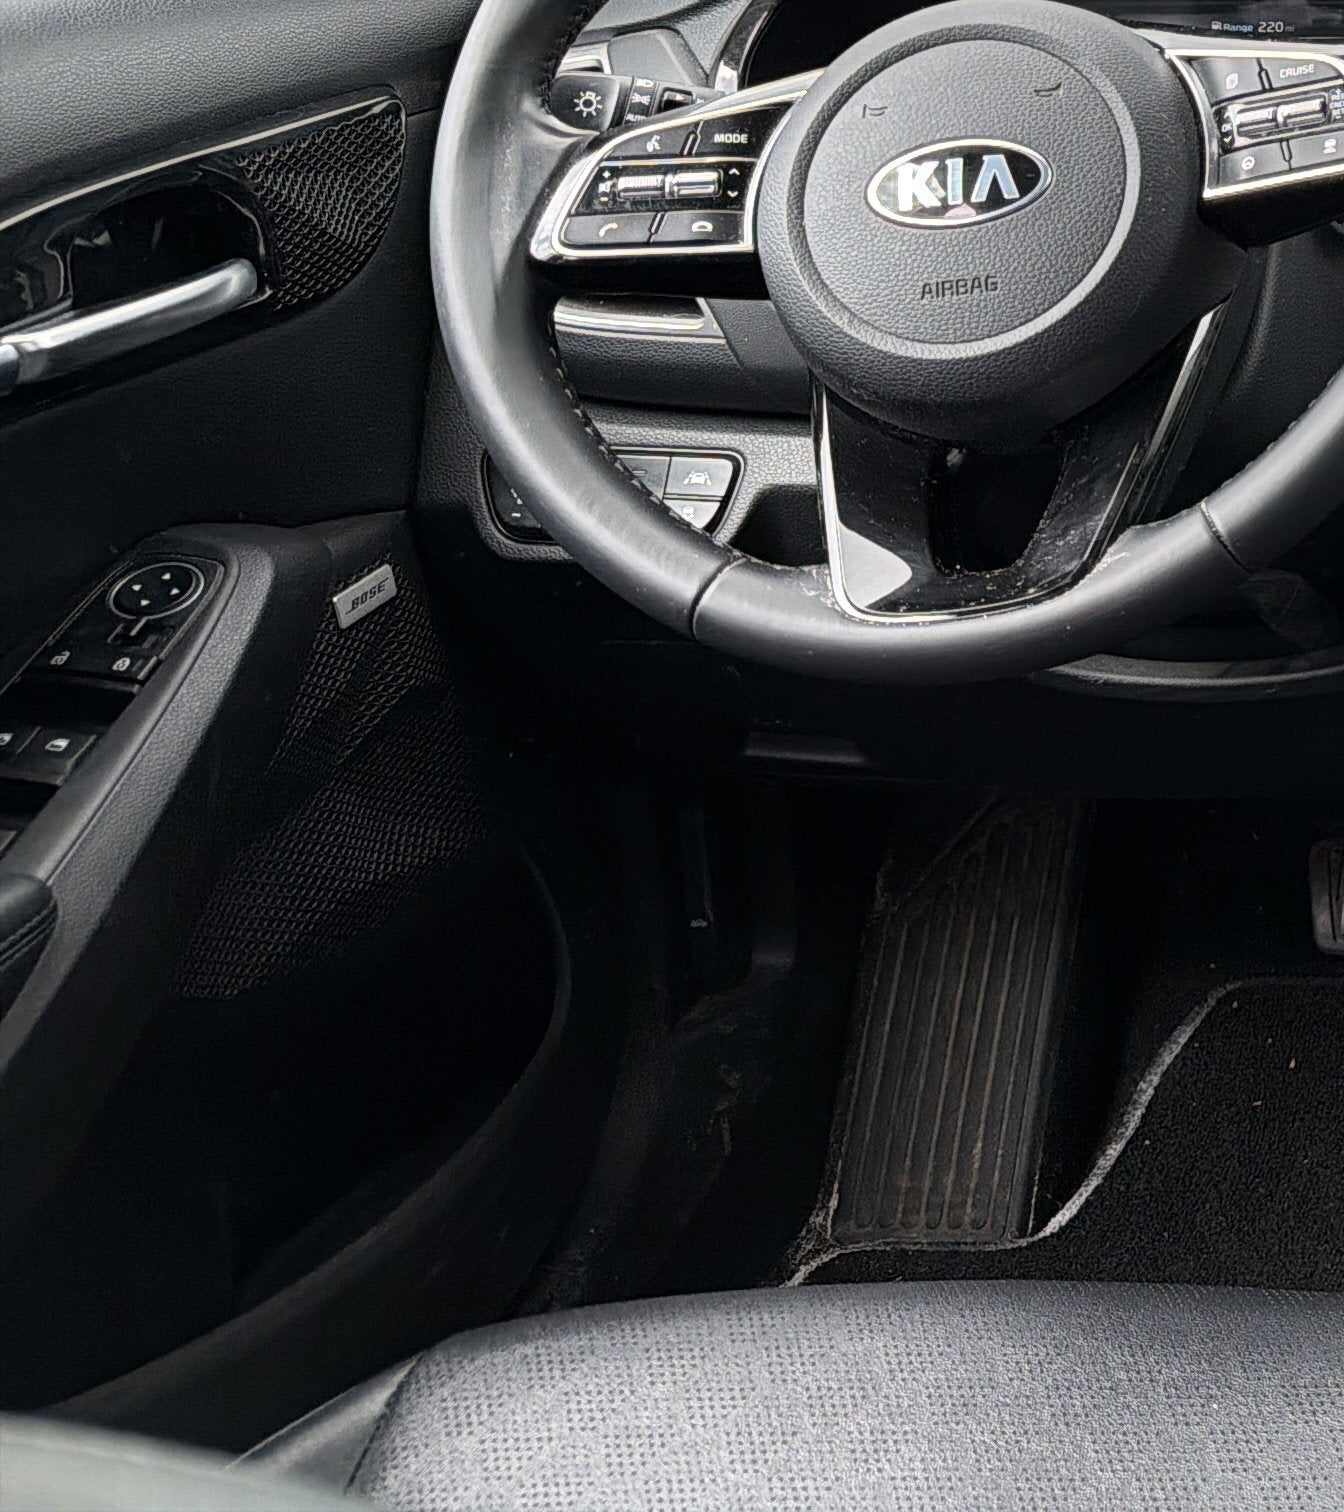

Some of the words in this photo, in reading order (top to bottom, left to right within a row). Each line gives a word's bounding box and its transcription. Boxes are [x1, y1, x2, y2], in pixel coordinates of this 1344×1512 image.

[1223, 23, 1254, 33] Range
[1258, 21, 1285, 33] 220
[1279, 64, 1315, 79] CRUISE
[713, 134, 749, 143] MODE
[896, 153, 1021, 212] KIA
[920, 275, 999, 300] AIRBAG
[345, 577, 389, 615] BOSE
